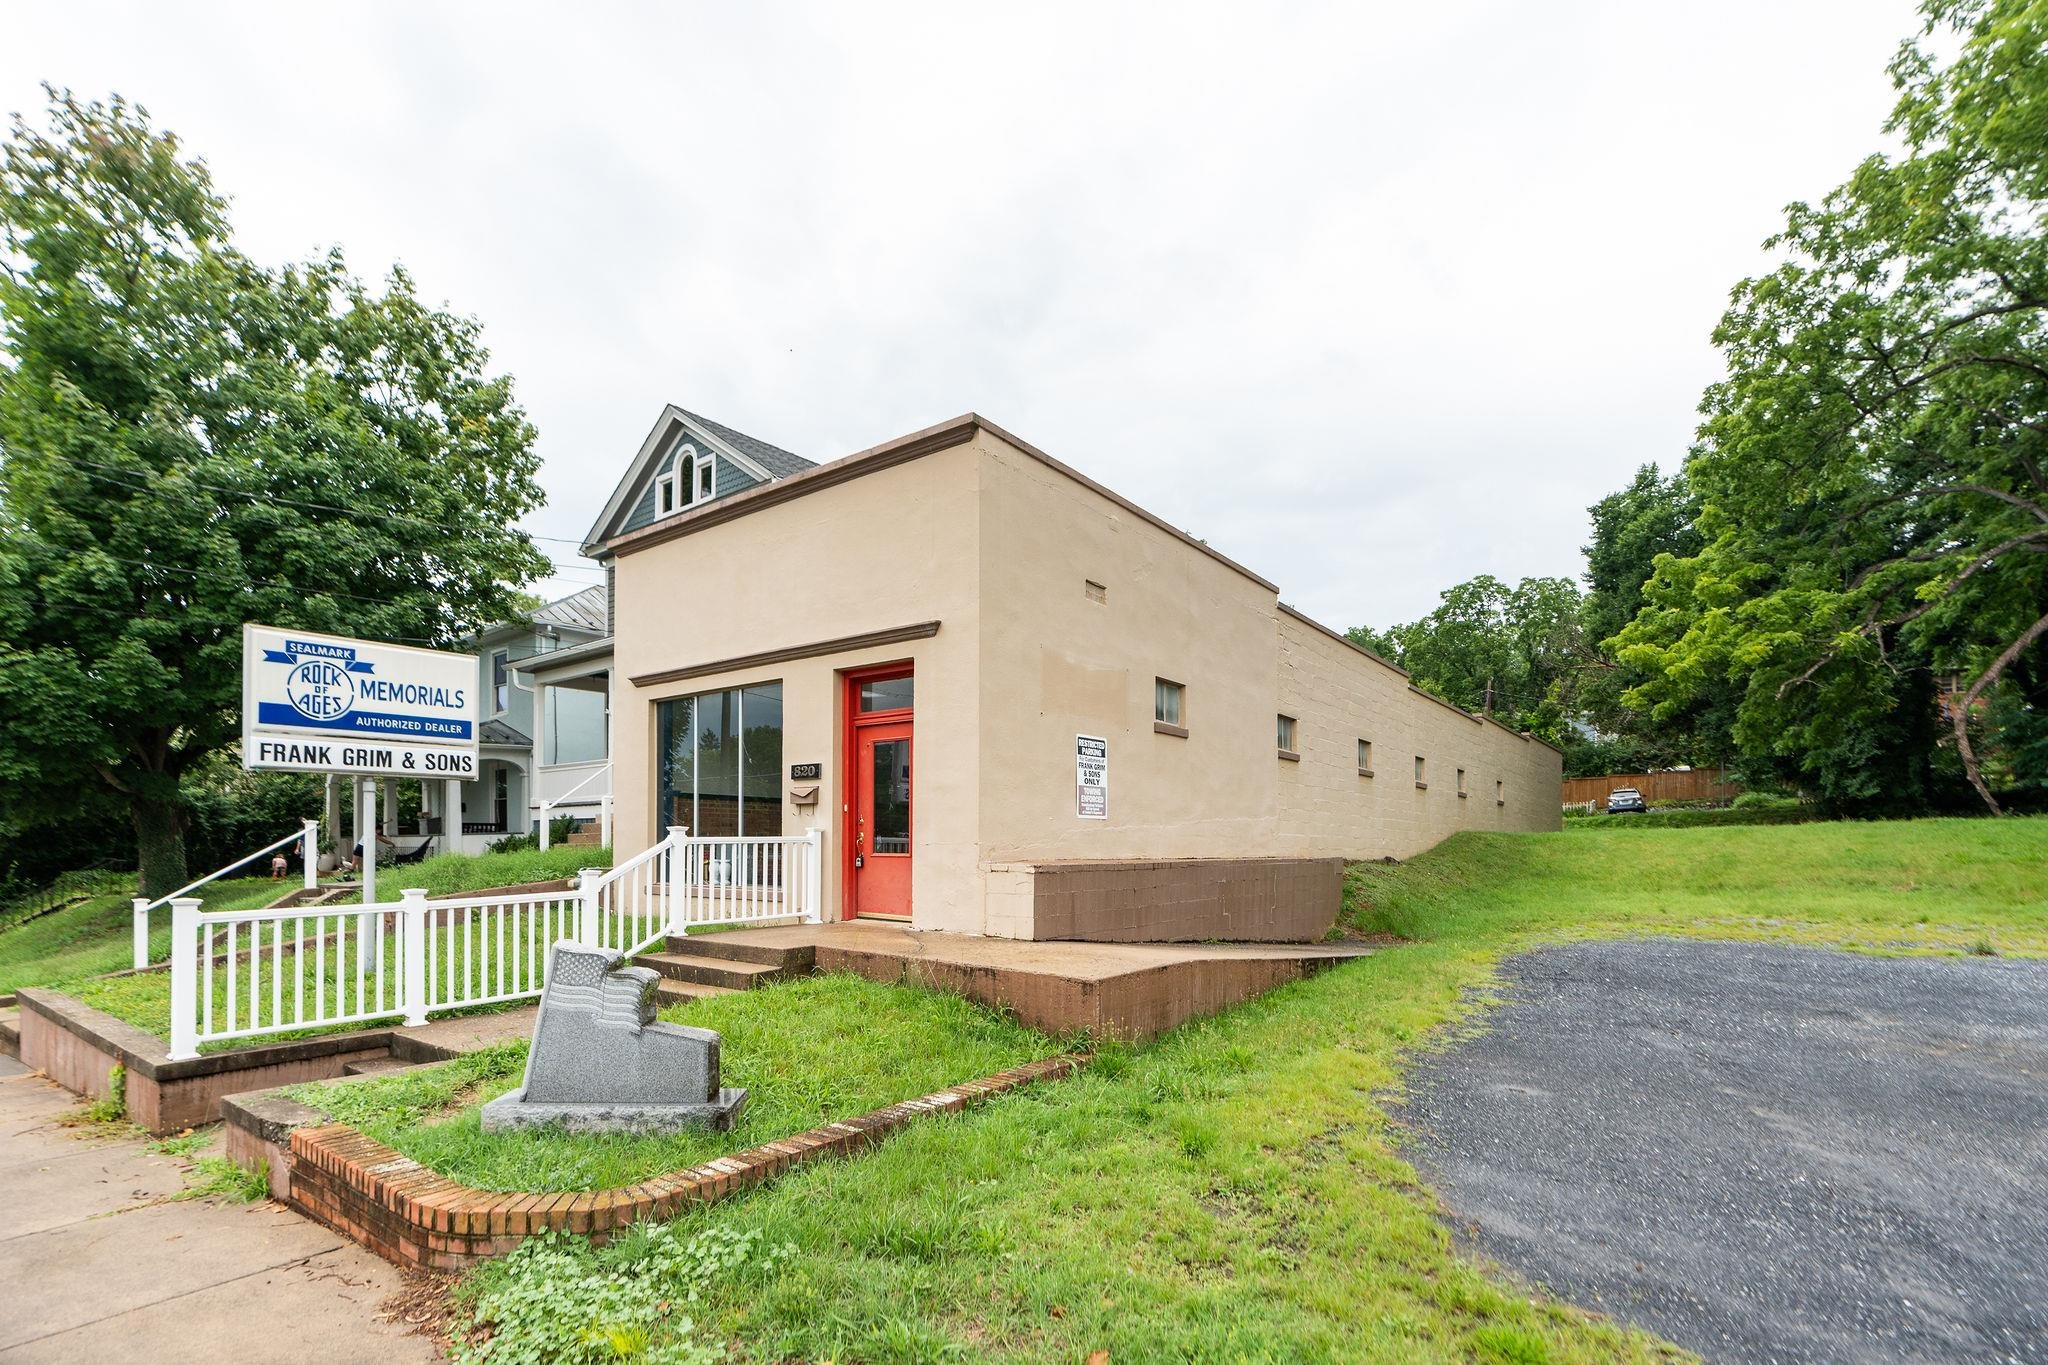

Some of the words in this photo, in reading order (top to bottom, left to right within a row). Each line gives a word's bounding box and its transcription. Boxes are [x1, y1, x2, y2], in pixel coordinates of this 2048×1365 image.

[290, 642, 352, 659] SEALMARK
[301, 666, 342, 687] ROCK
[315, 685, 328, 695] OF
[360, 679, 464, 709] MEMORIALS
[299, 694, 342, 715] AGES
[356, 716, 421, 731] AUTHORIZED
[425, 722, 463, 735] DEALER
[260, 742, 332, 765] FRANK
[342, 748, 392, 768] GRIM
[402, 752, 416, 769] &
[425, 753, 473, 772] SONS
[794, 765, 816, 777] 820
[1088, 770, 1101, 778] SONS
[1094, 763, 1105, 771] GRIM
